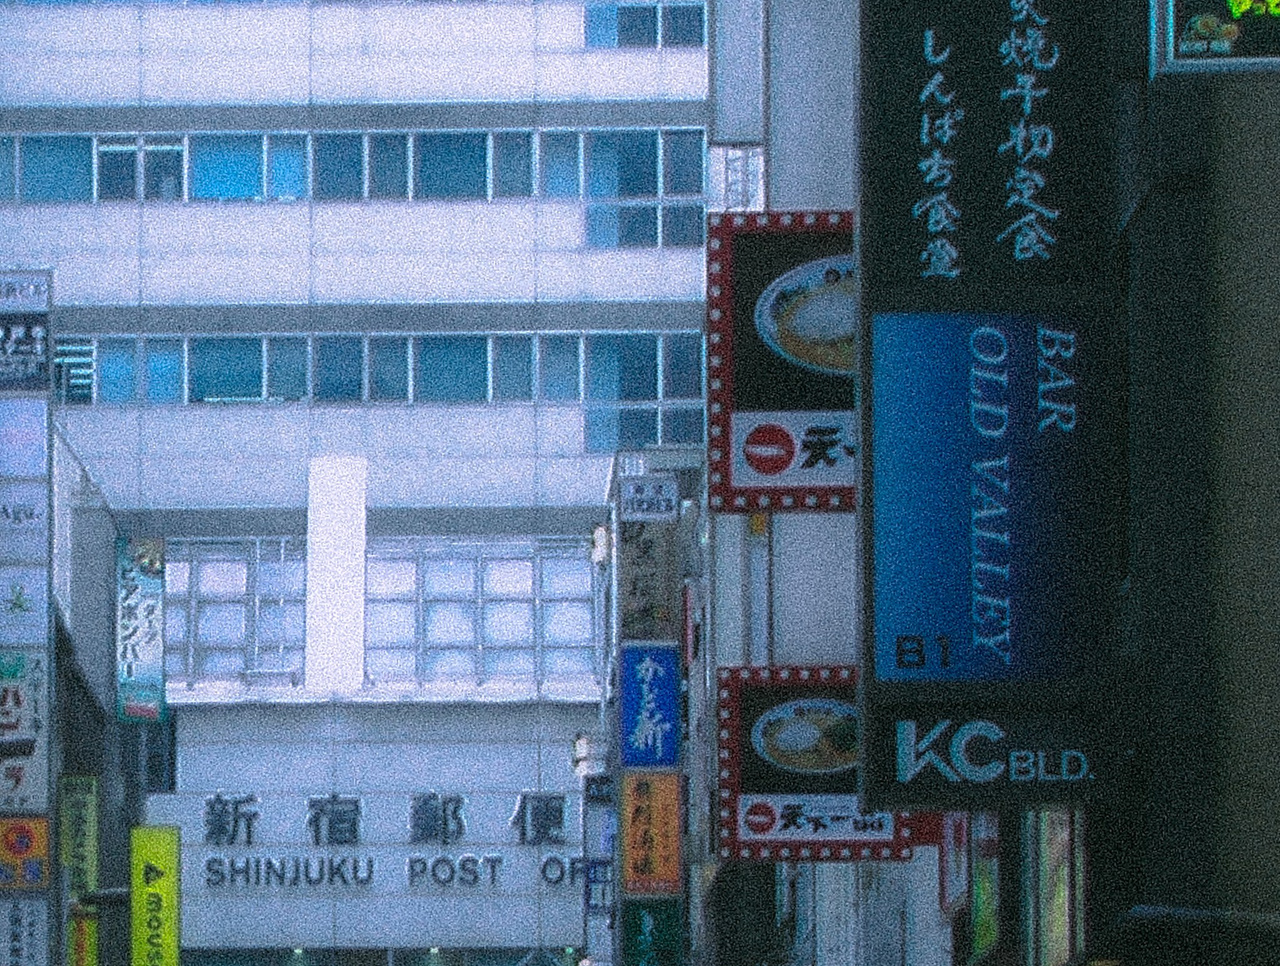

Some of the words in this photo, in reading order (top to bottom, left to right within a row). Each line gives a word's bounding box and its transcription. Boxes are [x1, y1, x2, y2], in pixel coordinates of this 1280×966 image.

[913, 28, 963, 280] しんぱち食堂
[970, 327, 1009, 439] OLD
[1037, 326, 1077, 433] BAR
[799, 427, 856, 469] 天
[971, 456, 1013, 666] VALLEY
[896, 636, 951, 669] B1
[896, 719, 1007, 784] KC
[1008, 751, 1095, 782] BLD.
[204, 792, 566, 846] 新宿郵便
[205, 857, 375, 888] SHINJUKU
[409, 855, 504, 886] POST
